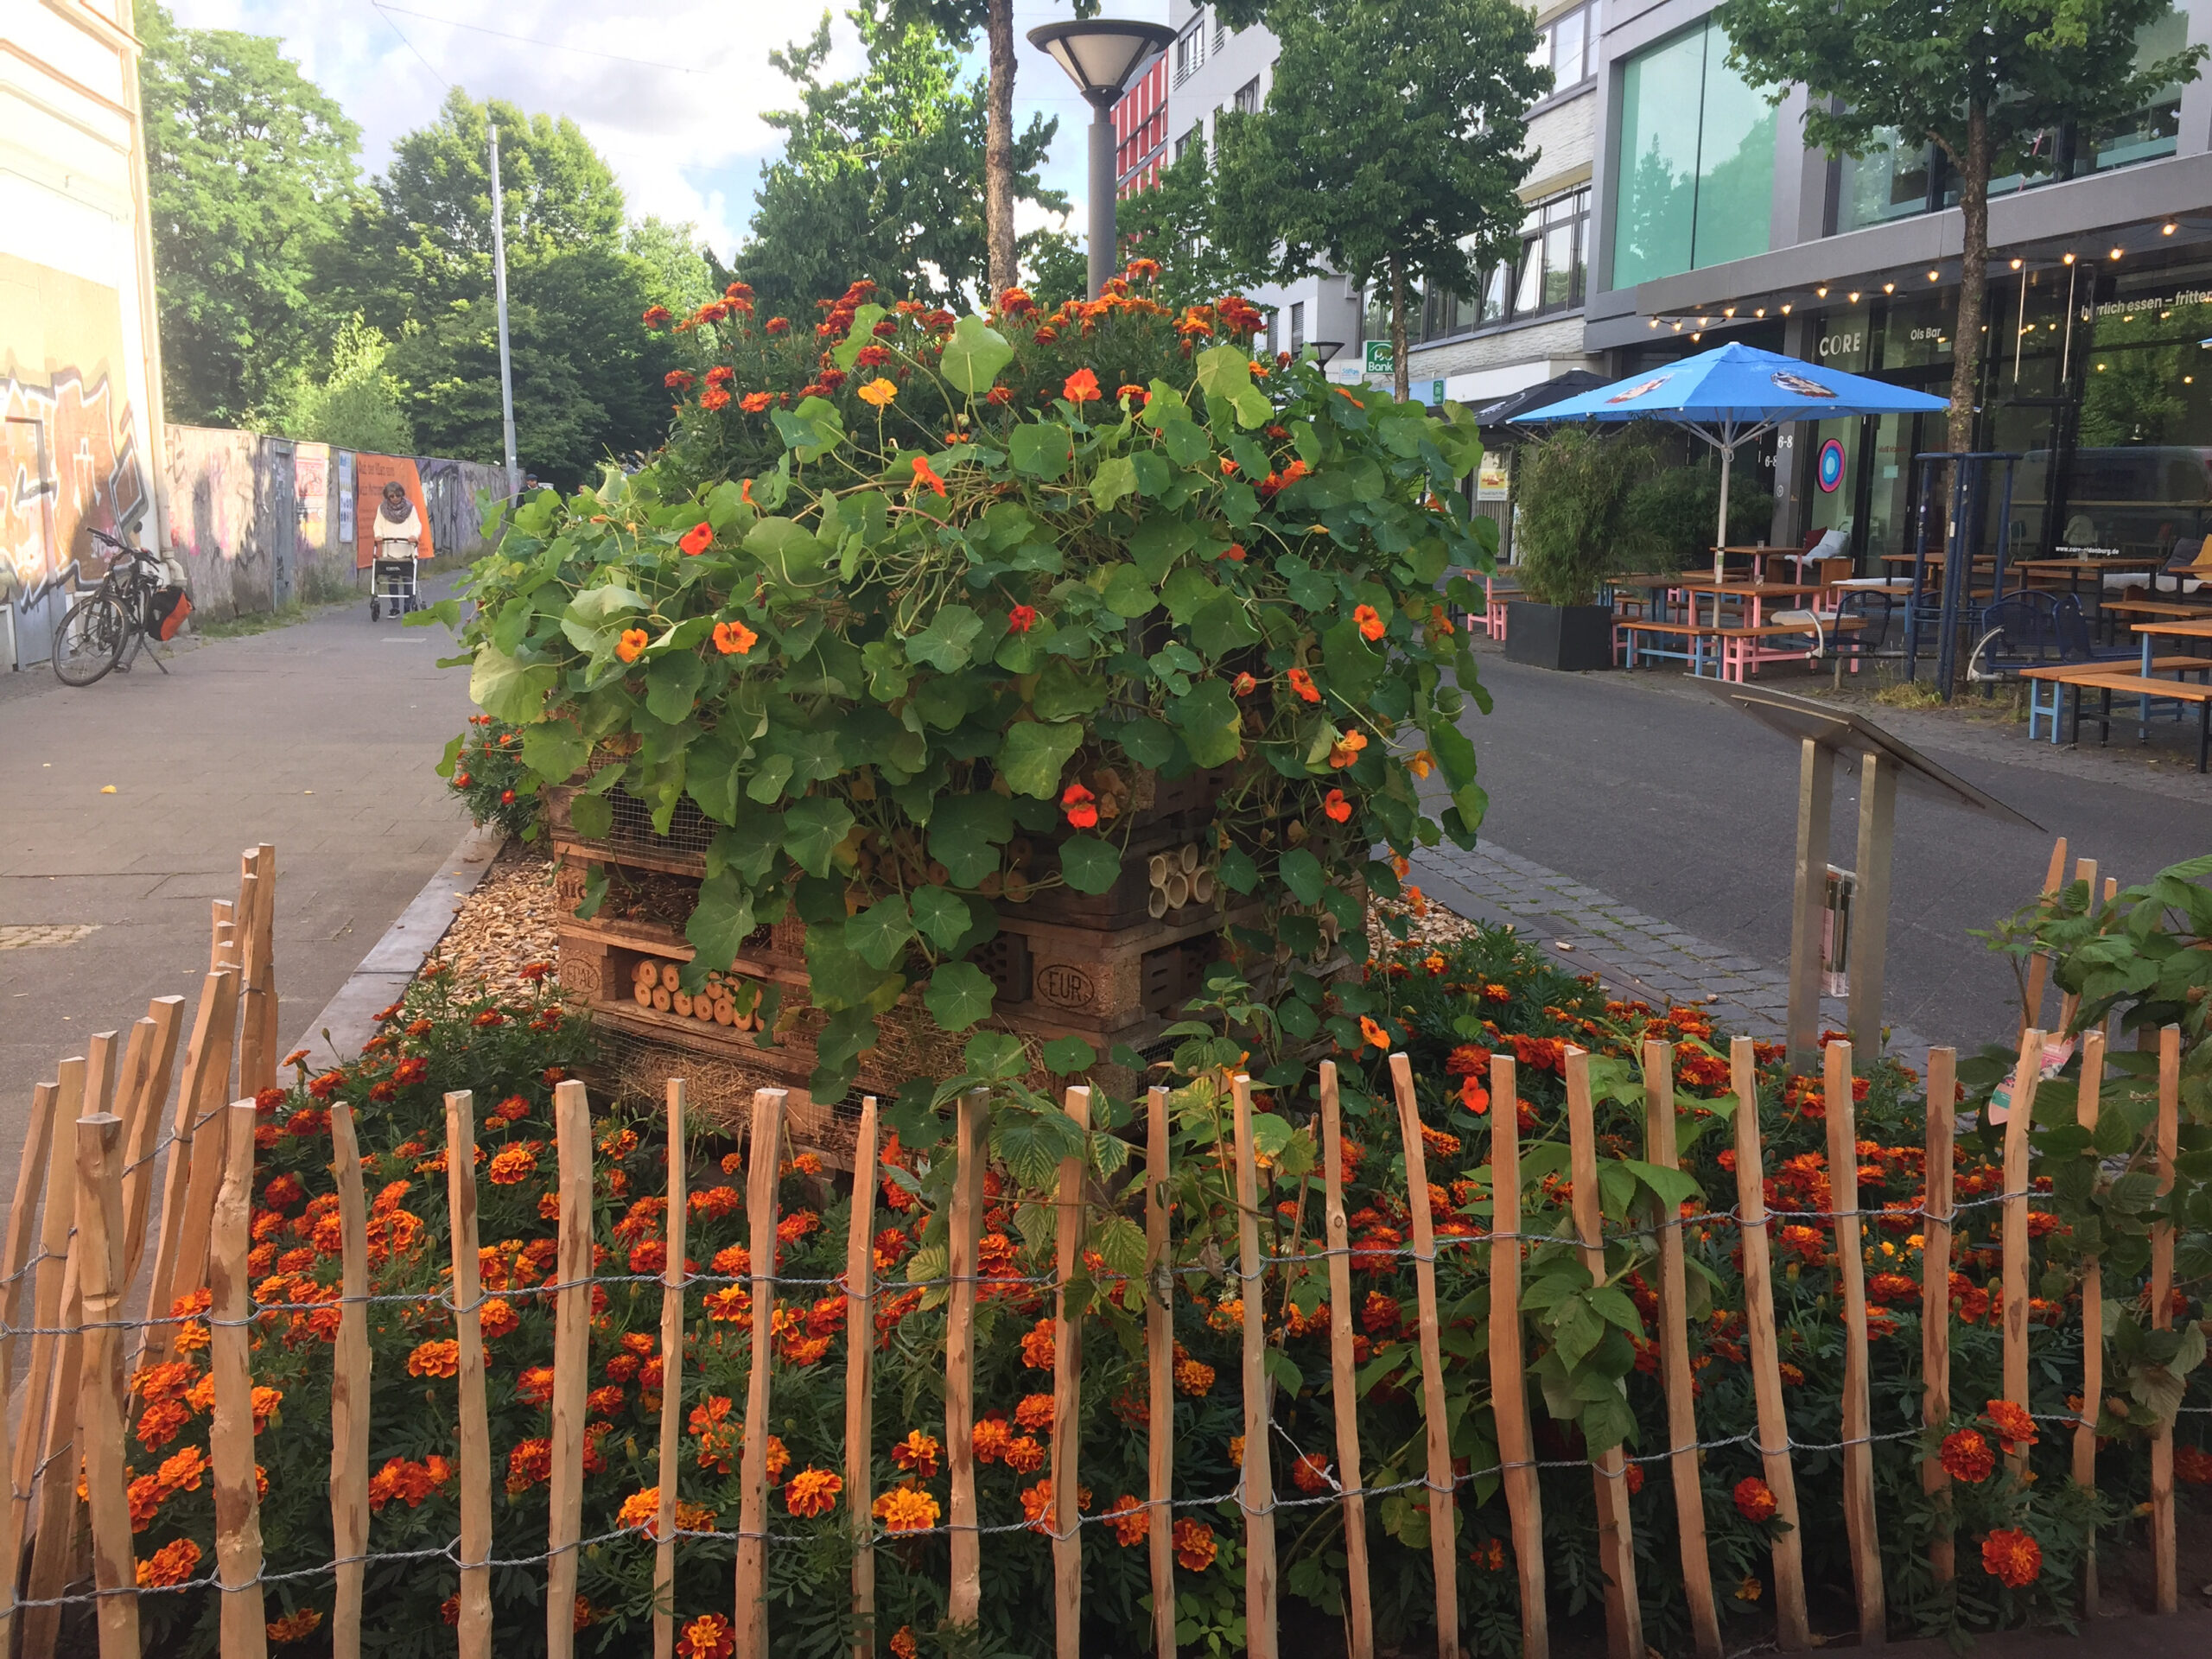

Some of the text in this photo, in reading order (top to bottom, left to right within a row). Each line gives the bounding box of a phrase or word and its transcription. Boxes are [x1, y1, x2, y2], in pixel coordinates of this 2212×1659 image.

[2081, 299, 2125, 318] hrrlich
[2127, 297, 2162, 312] essen
[1925, 327, 1942, 339] Bar
[1819, 332, 1861, 357] CORE
[1368, 361, 1394, 372] Bank
[1777, 435, 1793, 448] 6-8
[566, 964, 594, 989] EPAL
[1048, 971, 1083, 1001] EUR
